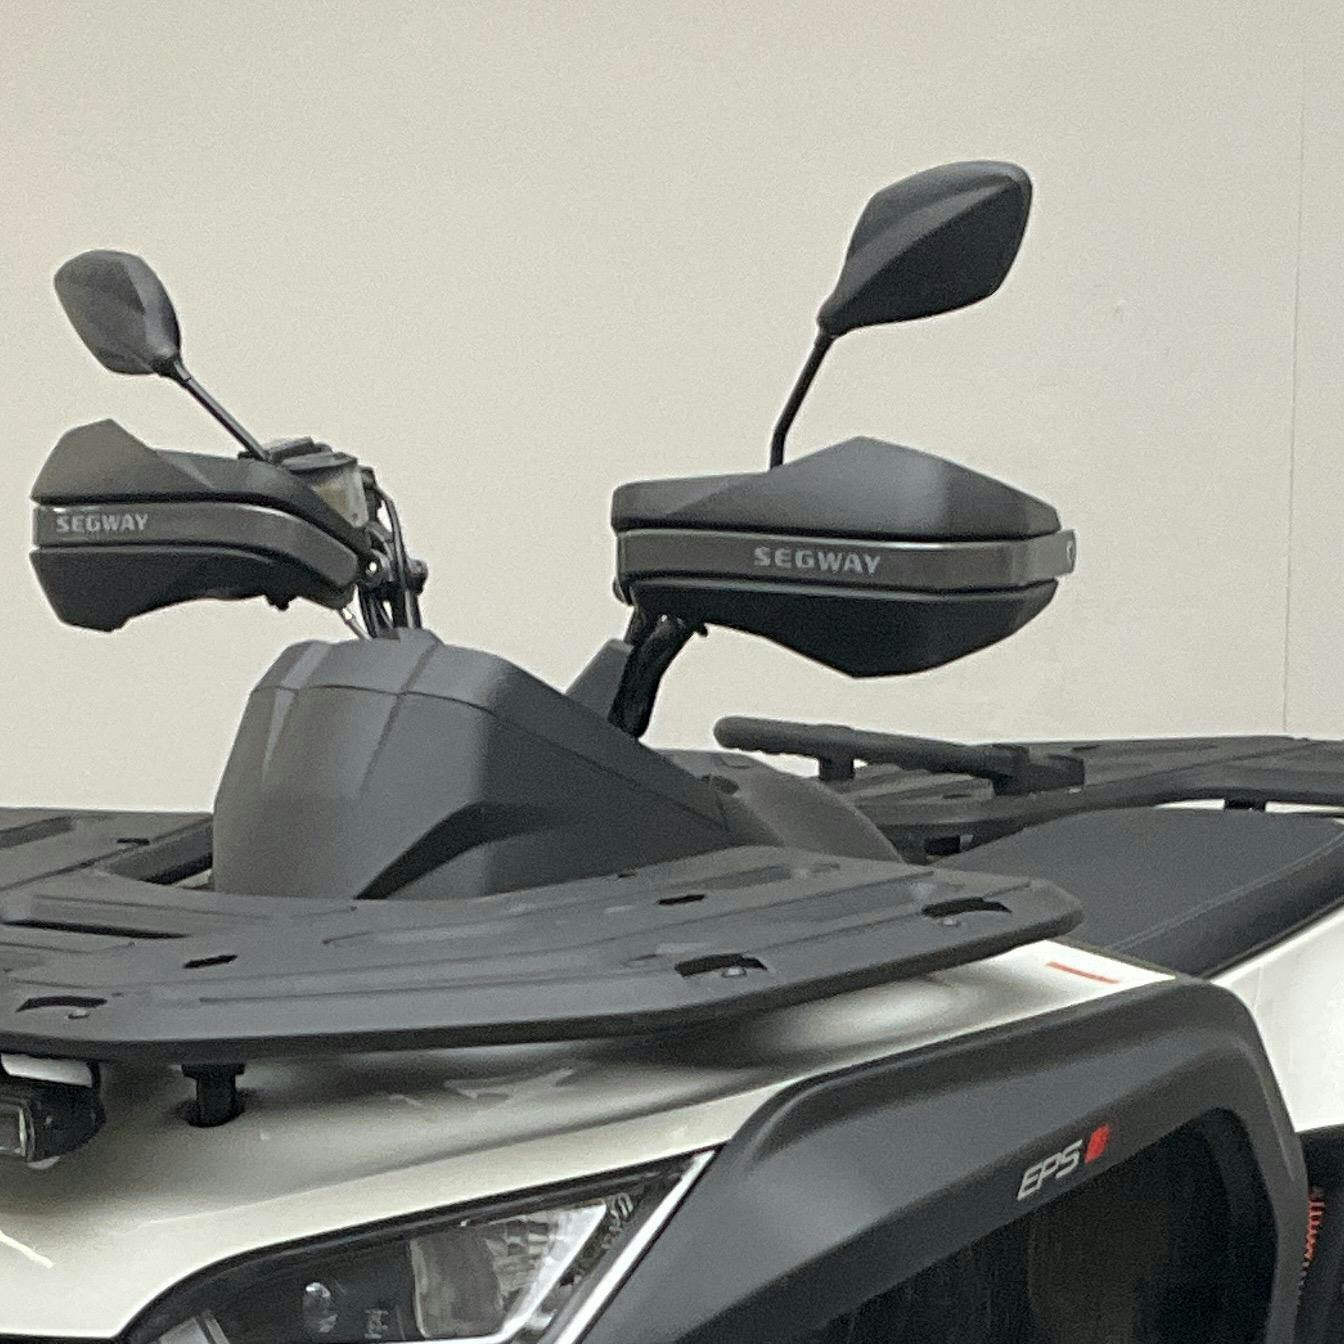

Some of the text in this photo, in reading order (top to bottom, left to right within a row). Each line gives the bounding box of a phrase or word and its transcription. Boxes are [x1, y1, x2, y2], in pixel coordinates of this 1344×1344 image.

[56, 513, 149, 533] SEGWAY
[754, 546, 881, 576] SEGWAY
[1017, 1139, 1083, 1200] EPS
